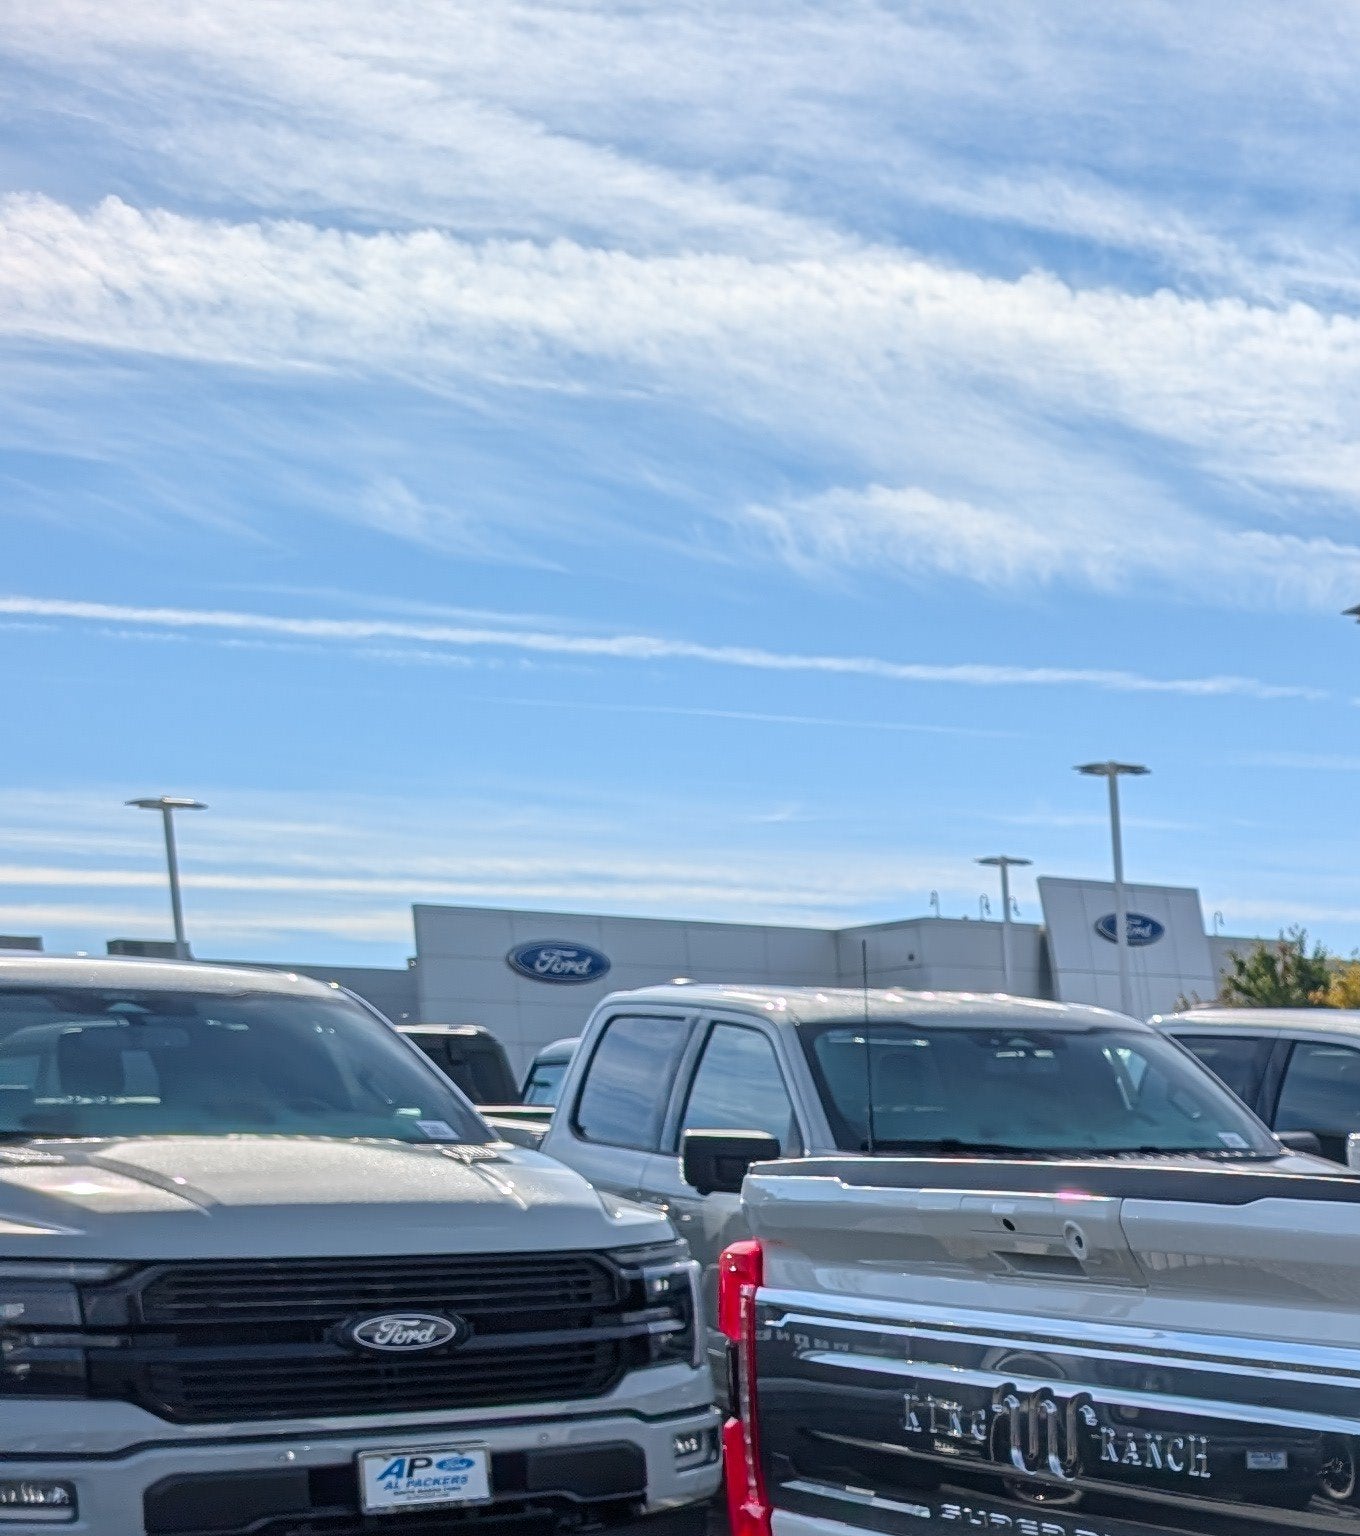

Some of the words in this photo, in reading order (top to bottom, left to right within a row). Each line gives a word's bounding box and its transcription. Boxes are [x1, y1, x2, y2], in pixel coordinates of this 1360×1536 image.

[534, 949, 592, 975] Ford
[374, 1319, 436, 1344] Ford
[903, 1394, 988, 1441] KING
[1098, 1426, 1211, 1479] RANCH
[376, 1457, 434, 1481] AP
